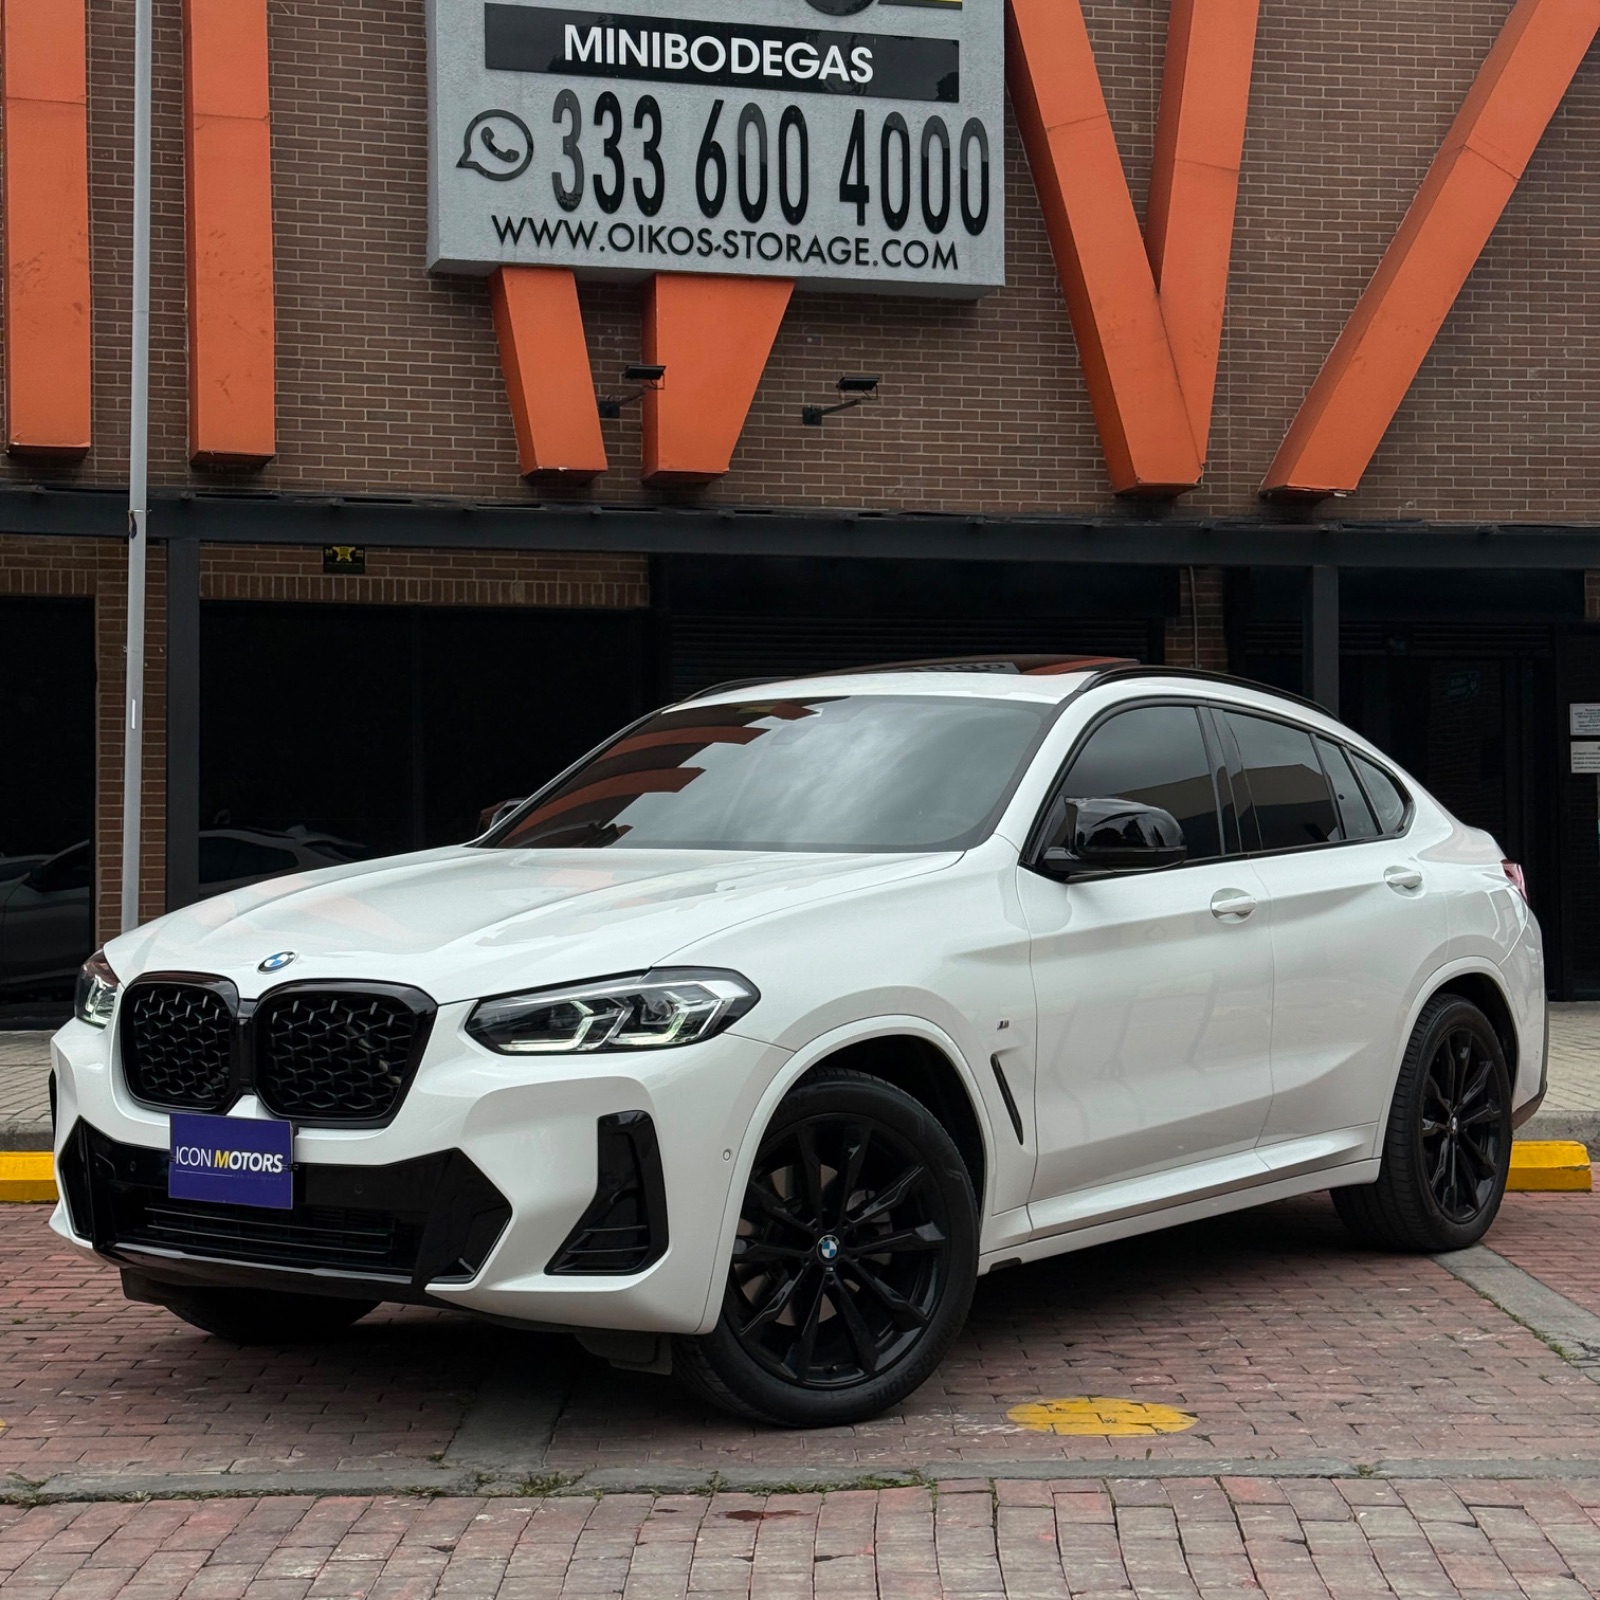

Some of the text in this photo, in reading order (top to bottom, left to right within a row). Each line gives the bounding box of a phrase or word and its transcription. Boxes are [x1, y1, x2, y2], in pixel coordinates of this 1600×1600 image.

[564, 24, 874, 84] MINIBODEGAS
[551, 88, 990, 238] 333 600 4000
[490, 214, 960, 271] WWW.OIKOS-STORAGE.COM
[175, 1145, 284, 1174] ICON MOTORS
